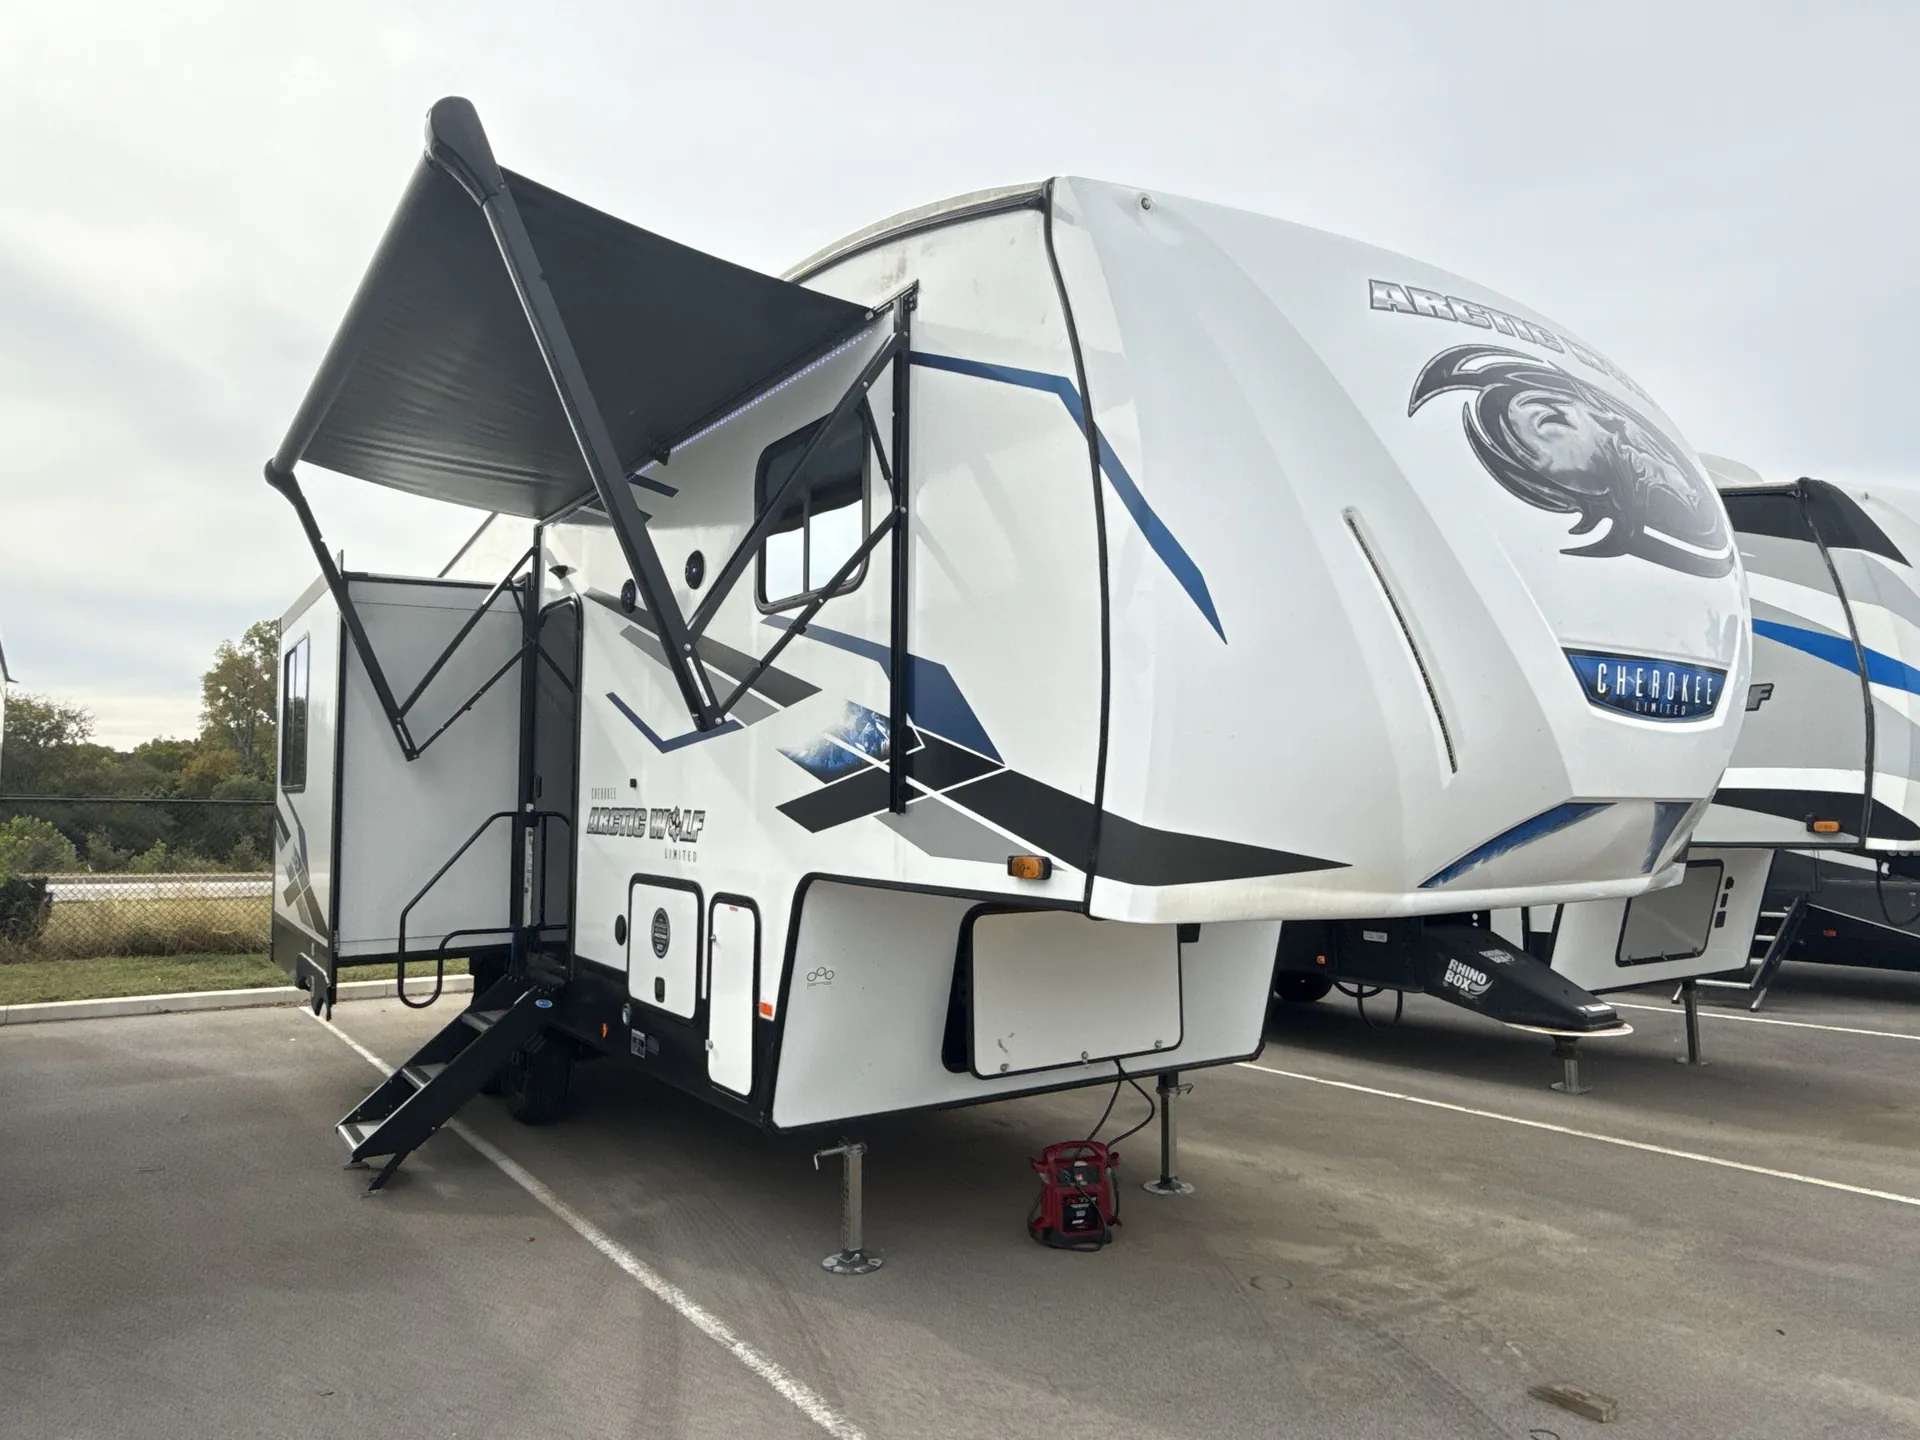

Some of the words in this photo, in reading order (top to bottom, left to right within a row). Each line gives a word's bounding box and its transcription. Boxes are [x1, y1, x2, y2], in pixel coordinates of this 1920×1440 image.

[1368, 278, 1565, 354] ARCTIC
[1597, 663, 1713, 705] CHEROKEE
[1635, 701, 1686, 716] LIMITED
[586, 807, 647, 838] ARCTIC
[664, 847, 697, 863] LIMITED
[1443, 969, 1472, 992] BOX
[1447, 958, 1487, 985] RHINO
